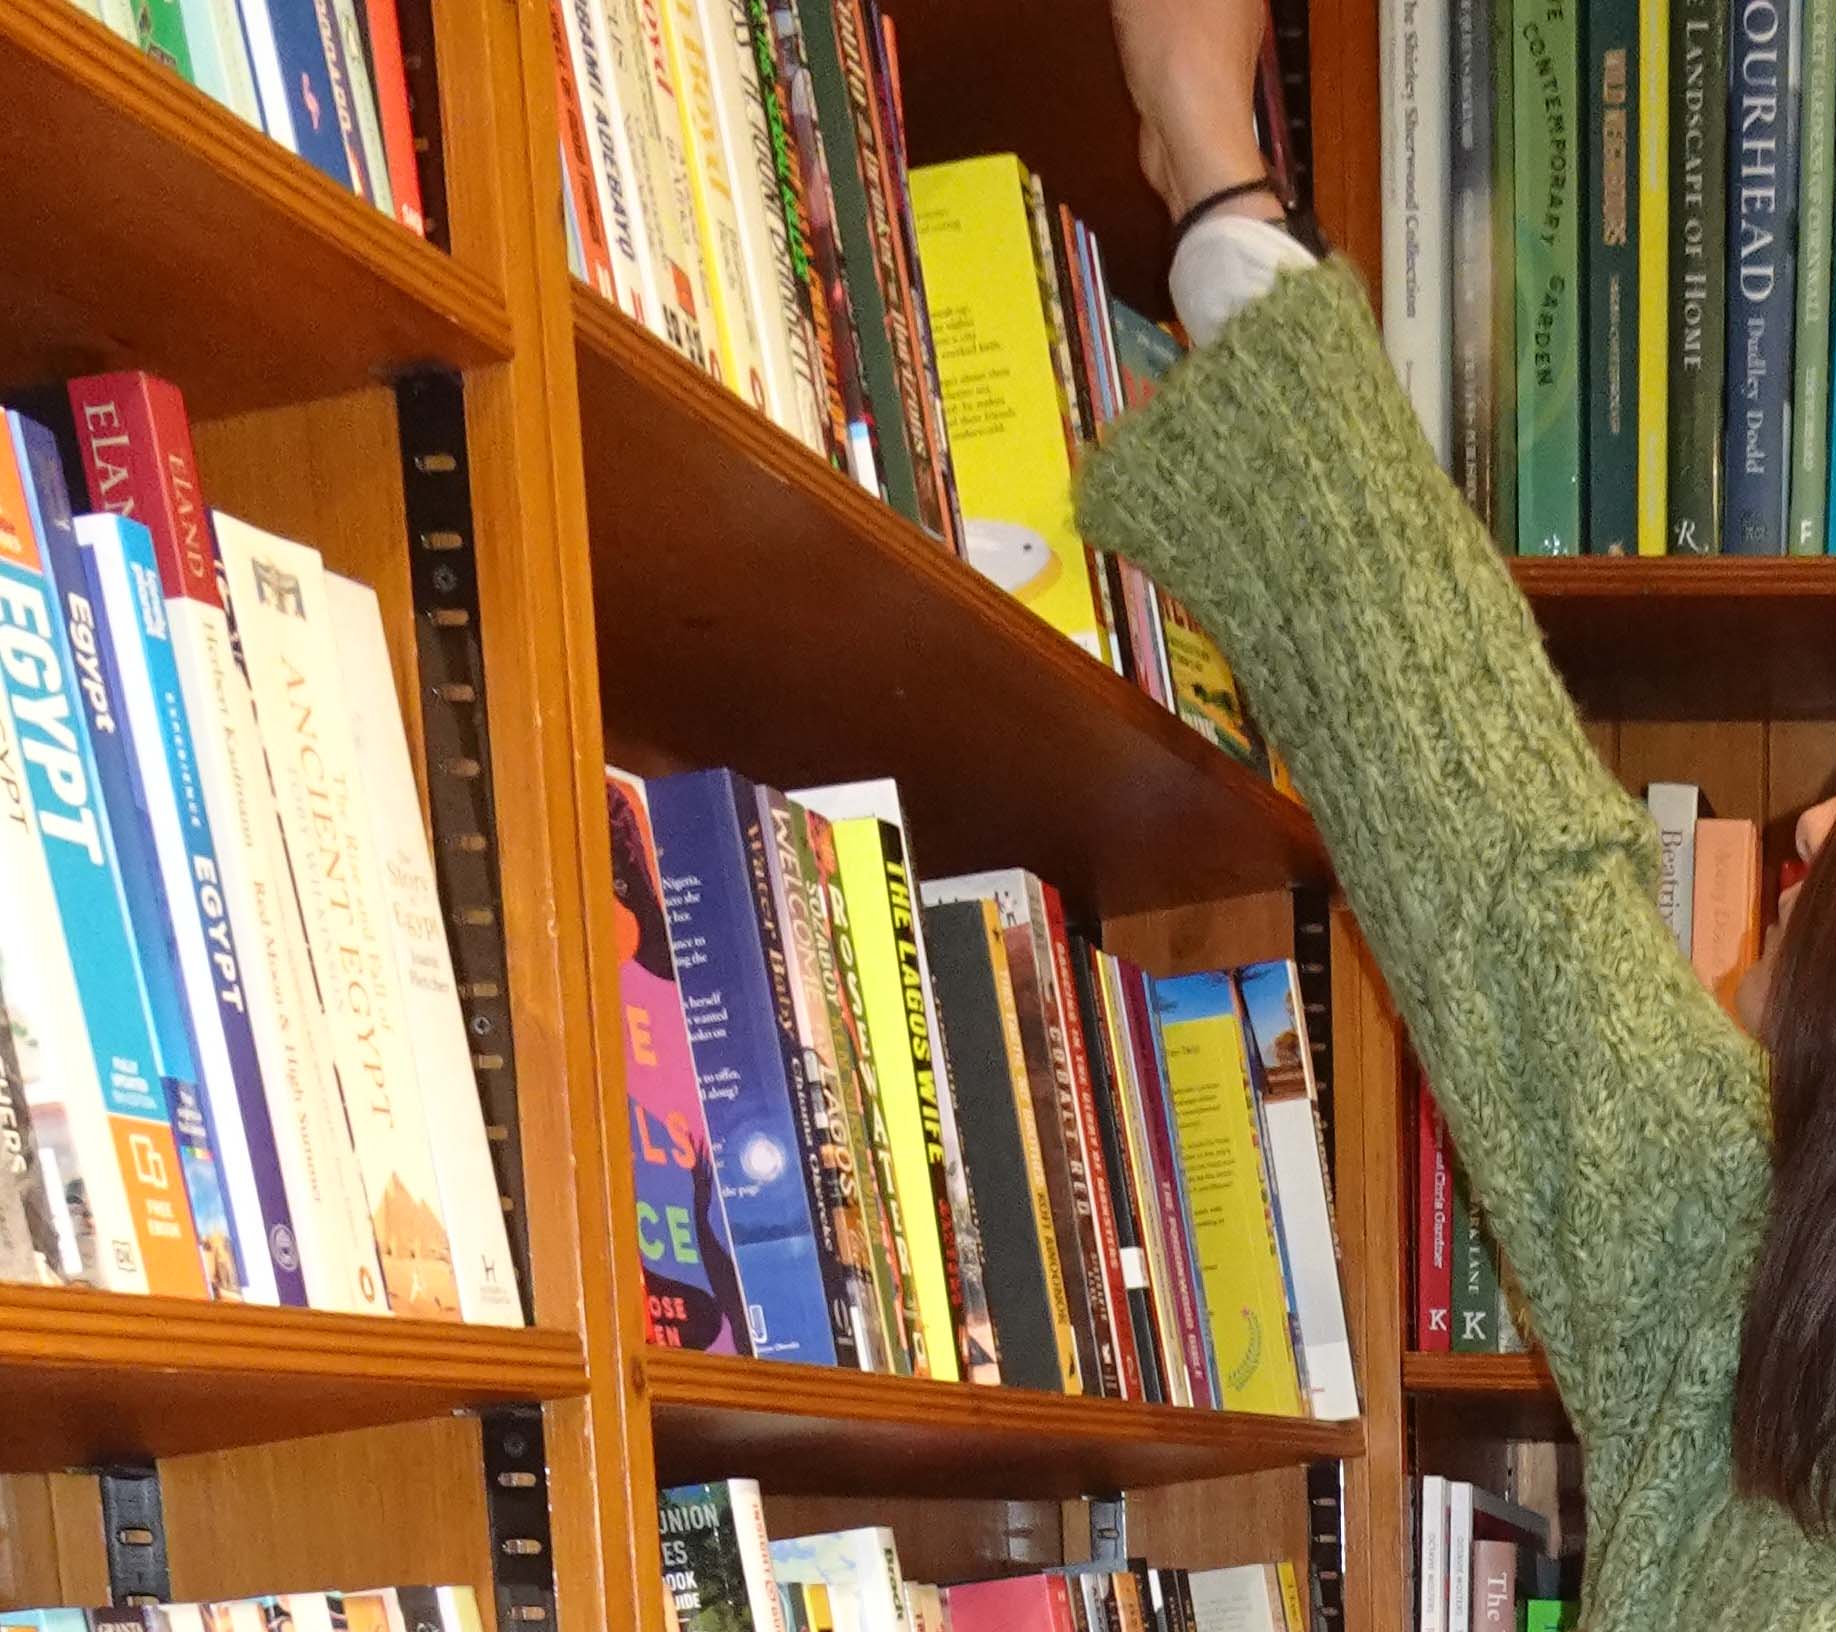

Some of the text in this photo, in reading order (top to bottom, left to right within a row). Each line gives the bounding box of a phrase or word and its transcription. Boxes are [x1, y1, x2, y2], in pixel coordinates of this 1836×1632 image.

[1745, 313, 1768, 474] Dudley Dodd
[0, 581, 105, 866] EGYPT
[194, 855, 245, 1012] EGYPT
[886, 861, 944, 1166] THE LAGOS WIFE
[1484, 1572, 1508, 1622] The
